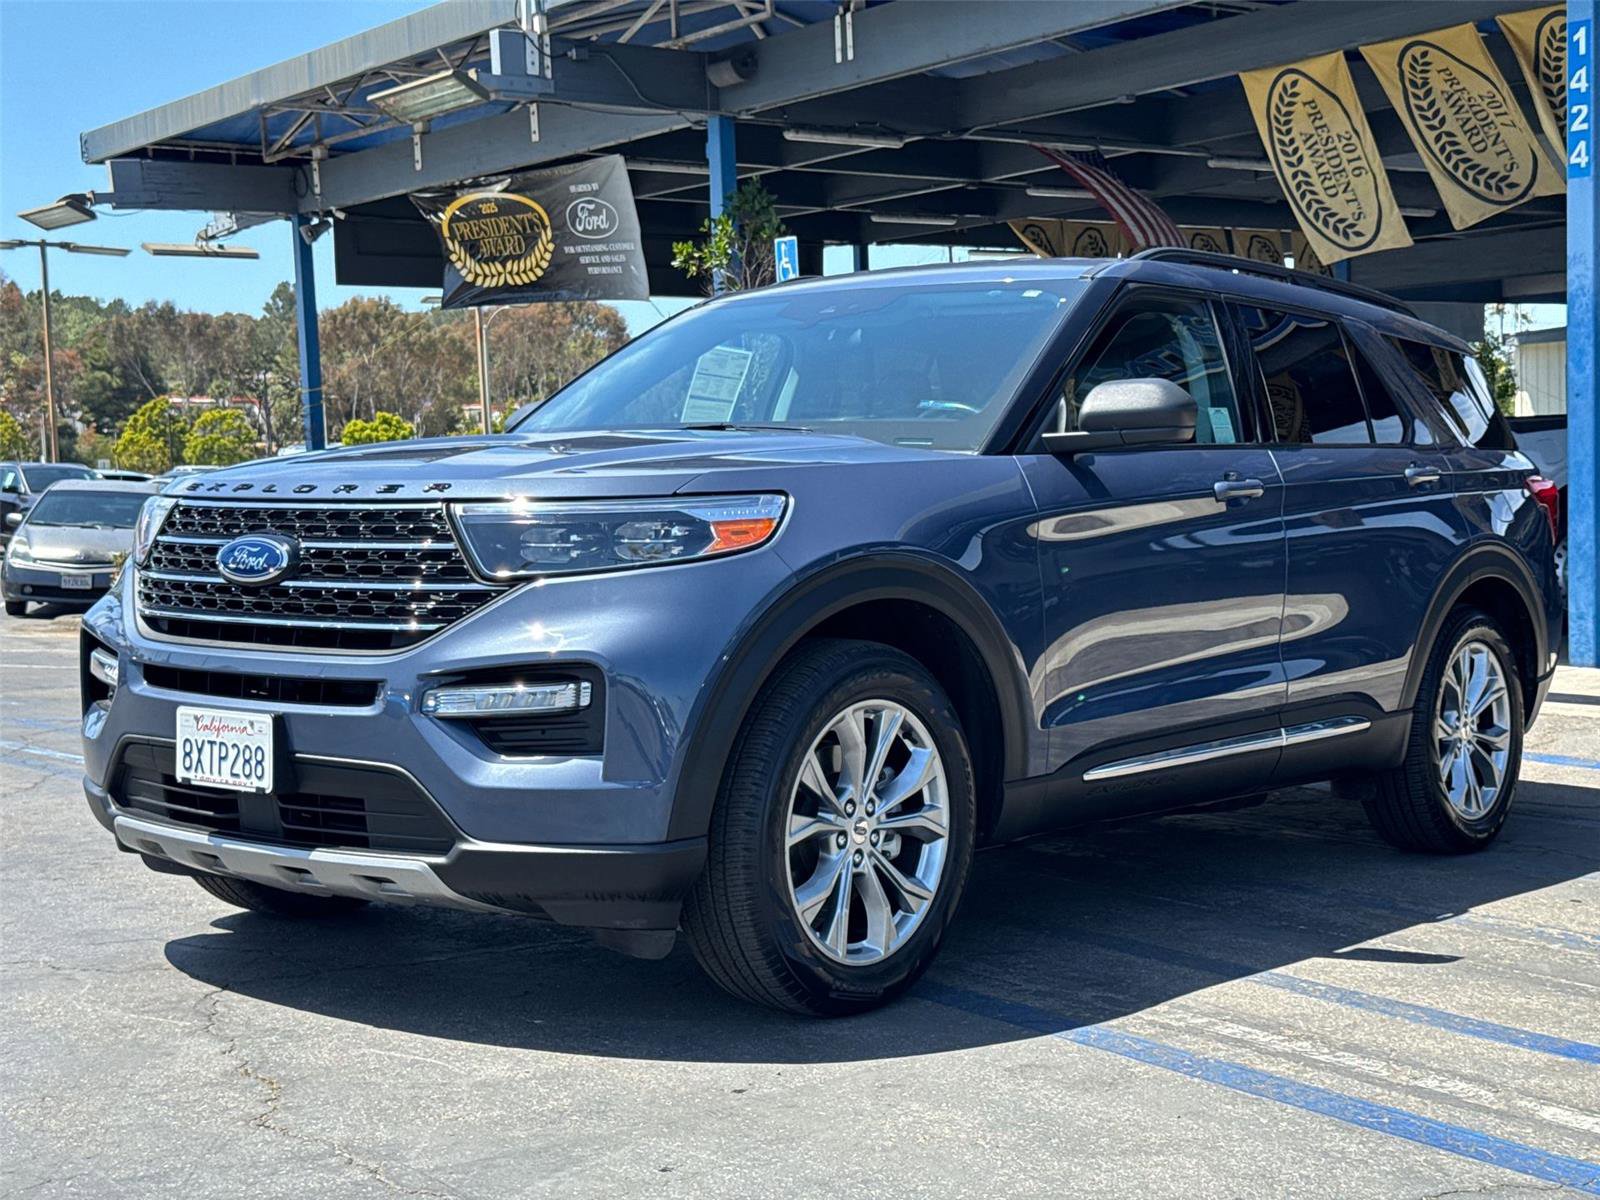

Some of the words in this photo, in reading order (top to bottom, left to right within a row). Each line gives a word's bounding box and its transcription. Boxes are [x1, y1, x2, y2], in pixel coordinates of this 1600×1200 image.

[1436, 66, 1520, 174] PRESIDENT'S
[1440, 88, 1489, 154] AWARD
[1478, 90, 1517, 129] 2017
[1300, 131, 1340, 198] AWARD
[1302, 98, 1366, 222] PRESIDENT'S
[1336, 130, 1369, 178] 2016
[451, 212, 542, 242] PRESIDENT'S
[575, 203, 610, 232] Ford
[479, 234, 526, 258] AWARD
[185, 483, 452, 495] EXPLORER
[228, 545, 270, 571] Ford
[196, 714, 255, 738] California
[182, 738, 266, 782] 8XTP288
